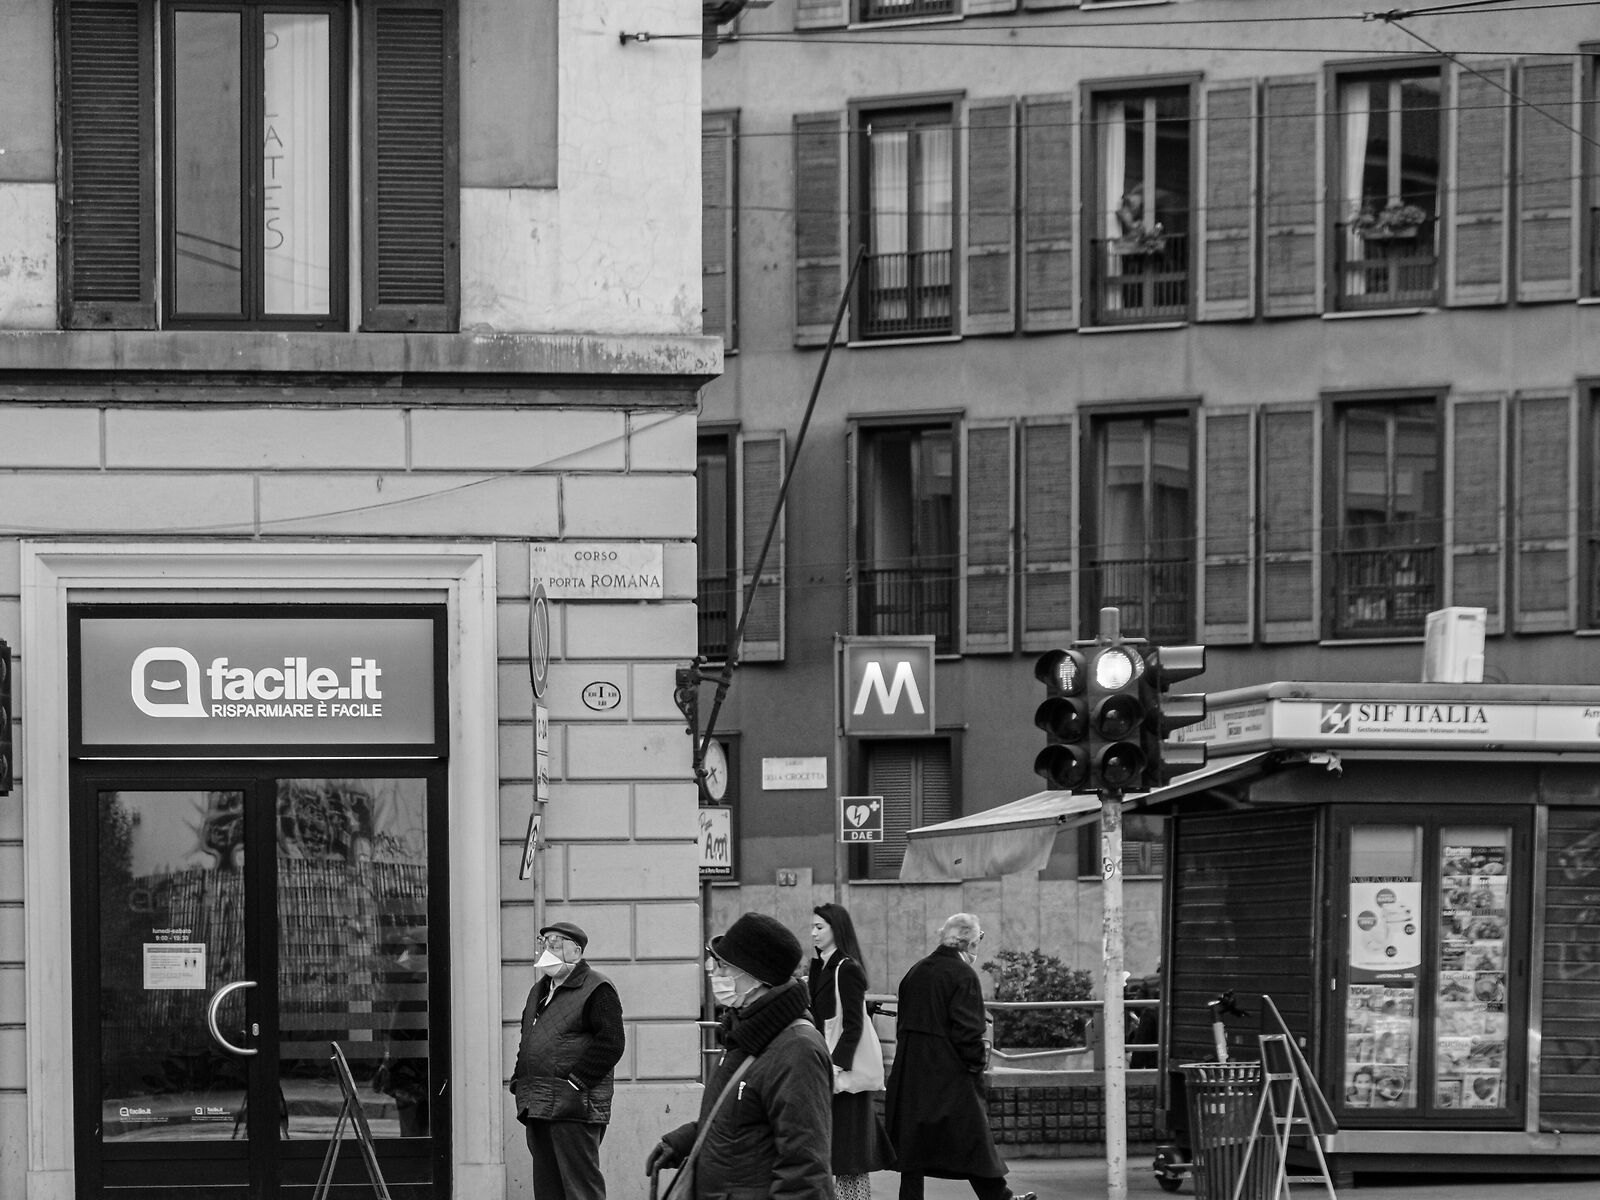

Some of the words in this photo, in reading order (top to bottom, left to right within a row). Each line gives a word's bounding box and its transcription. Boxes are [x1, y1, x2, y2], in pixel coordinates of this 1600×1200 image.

[574, 551, 618, 561] CORSO
[549, 577, 586, 588] PORTA
[591, 574, 661, 588] ROMANA
[206, 656, 383, 701] facile.it
[852, 661, 925, 715] M
[211, 703, 314, 718] RISPARMIARE
[317, 700, 328, 718] È
[331, 703, 383, 718] FACILE
[1358, 703, 1397, 722] SIF
[1403, 704, 1488, 723] ITALIA
[851, 831, 873, 841] DAE
